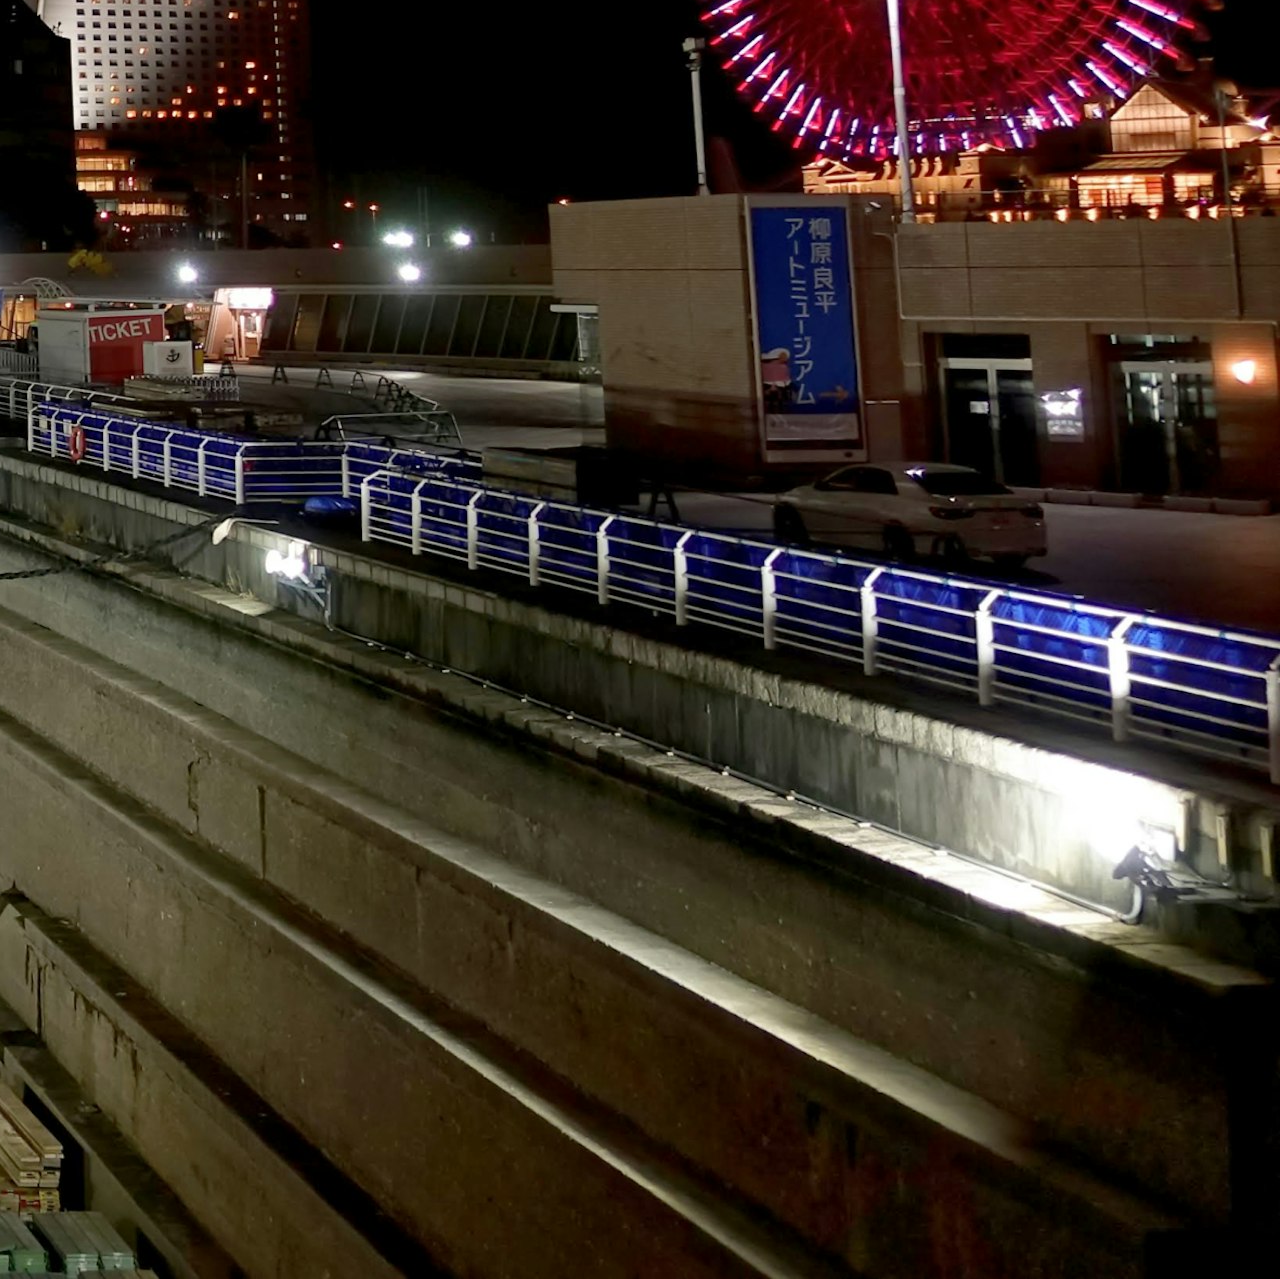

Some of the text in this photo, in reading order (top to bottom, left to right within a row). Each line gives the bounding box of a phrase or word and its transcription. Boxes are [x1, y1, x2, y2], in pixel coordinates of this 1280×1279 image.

[784, 217, 816, 406] アートミュージアム
[807, 217, 838, 314] 柳原良平
[88, 318, 152, 343] TICKET
